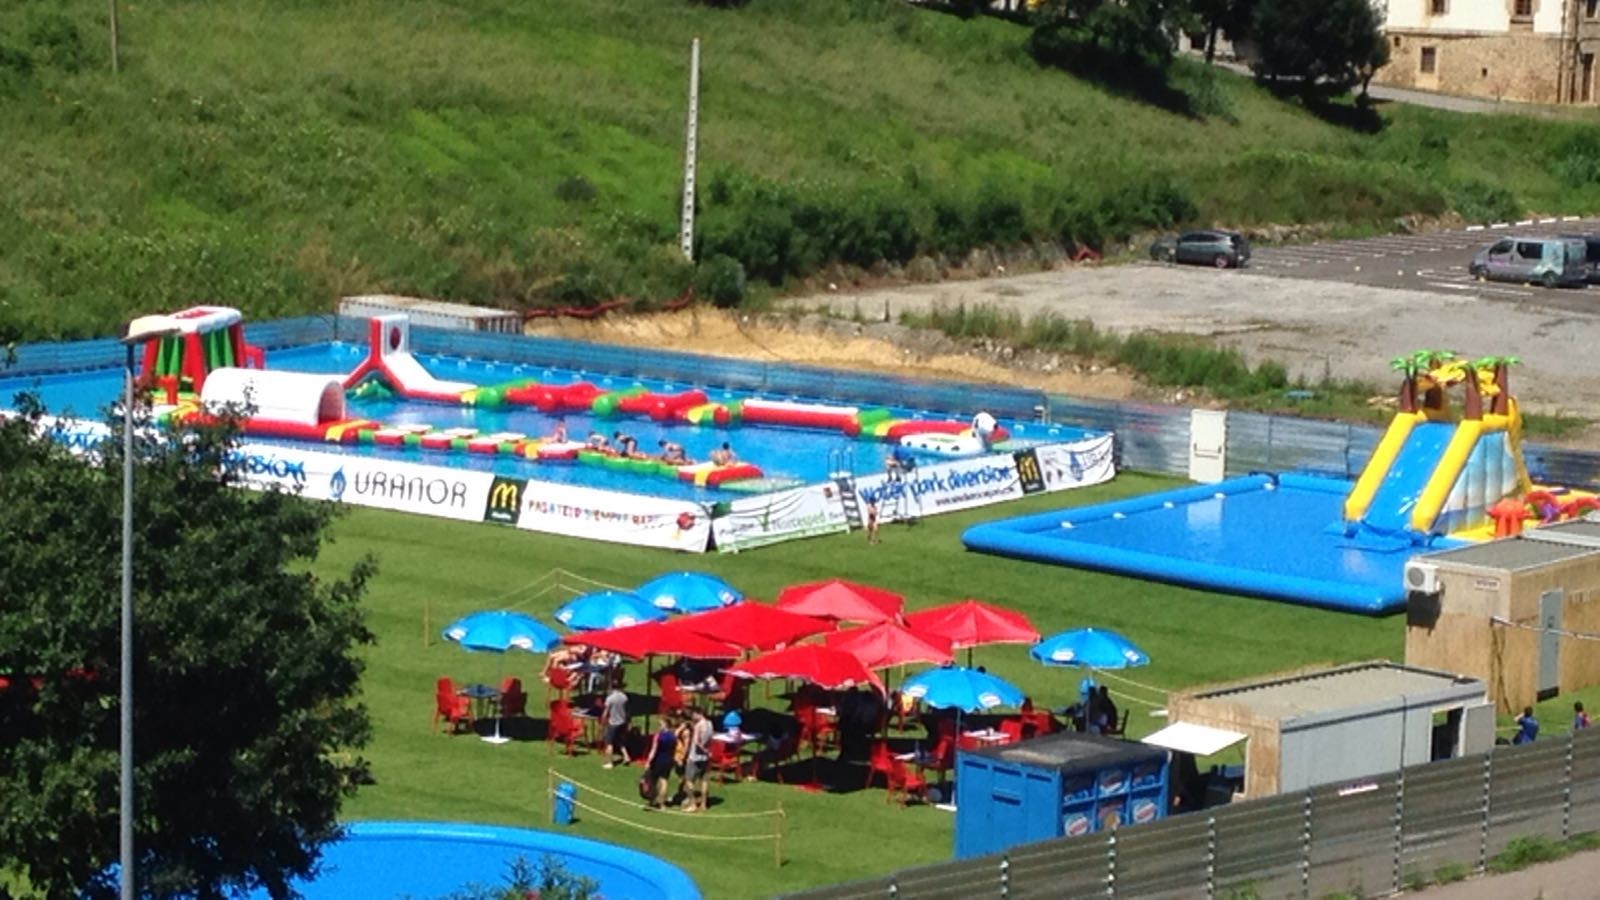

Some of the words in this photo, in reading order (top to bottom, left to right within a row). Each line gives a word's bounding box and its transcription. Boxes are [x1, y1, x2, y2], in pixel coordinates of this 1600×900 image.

[354, 471, 468, 508] URANOR
[910, 471, 948, 502] park
[947, 465, 1013, 491] diversion
